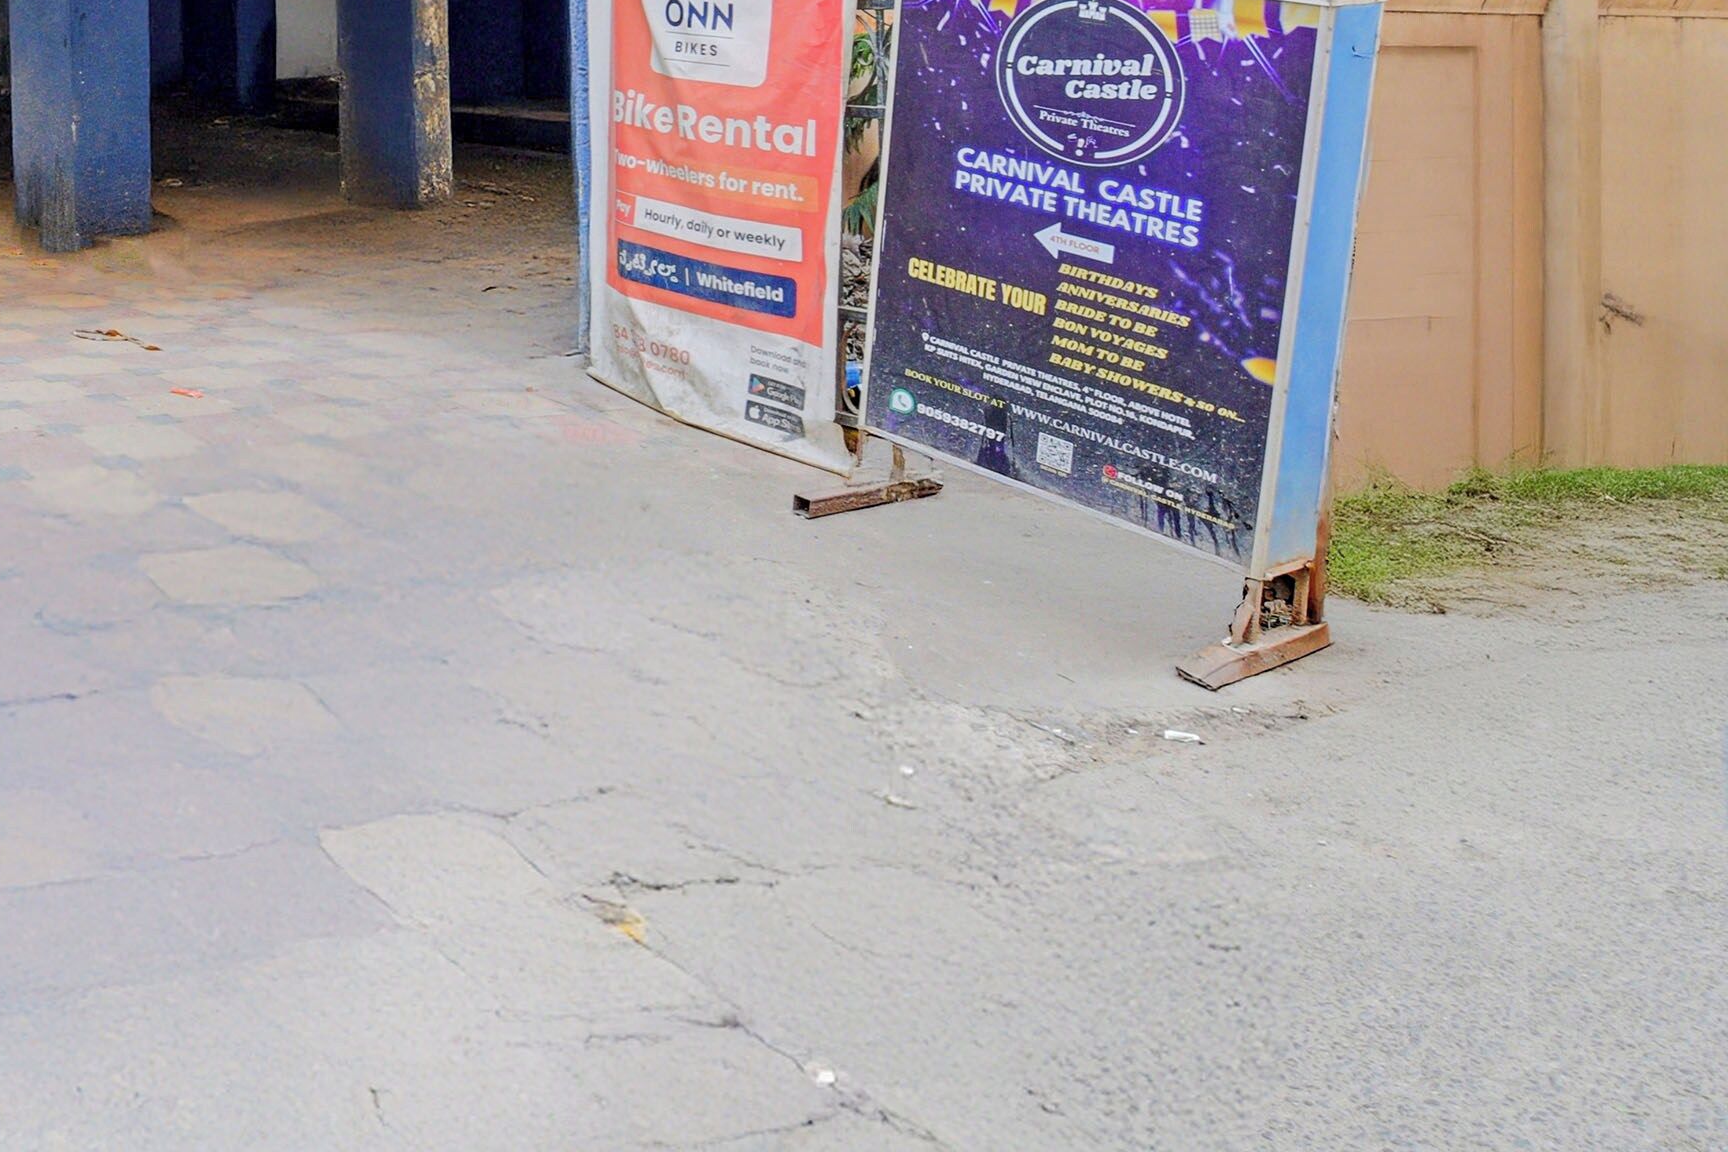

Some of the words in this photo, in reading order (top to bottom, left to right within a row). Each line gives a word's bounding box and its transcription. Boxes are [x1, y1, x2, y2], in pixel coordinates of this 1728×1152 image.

[674, 40, 719, 57] BIKES
[1016, 52, 1154, 78] Carnival
[1065, 78, 1157, 102] Castle
[1039, 110, 1078, 127] Private
[1080, 118, 1130, 138] Theatres
[615, 150, 715, 188] wo-wheelers
[719, 172, 747, 192] for
[752, 180, 805, 202] rent.
[956, 147, 1085, 194] CARNIVAL
[1098, 179, 1204, 222] CASTLE
[955, 170, 1057, 213] PRIVATE
[1063, 195, 1200, 248] THEATRES
[644, 208, 685, 230] Hourly,
[686, 219, 714, 239] daily
[717, 228, 730, 239] or
[734, 232, 786, 252] weekly
[1049, 234, 1068, 246] 4TH
[1068, 237, 1100, 254] FLOOR
[696, 271, 784, 303] Whitefield
[907, 257, 996, 302] CELEBRATE
[1000, 282, 1048, 316] YOUR
[1058, 263, 1160, 299] BIRTHDAYS
[1054, 298, 1108, 323] BRIDE
[1109, 313, 1132, 330] TO
[1132, 321, 1159, 338] BE
[1056, 281, 1192, 328] ANNIVERSARIES
[750, 345, 792, 363] Download
[1050, 334, 1096, 357] MOM
[1096, 348, 1120, 365] TO
[1120, 355, 1146, 372] BE
[1052, 316, 1089, 336] BON
[1090, 326, 1170, 360] VOYAGES
[904, 368, 932, 385] BOOK
[931, 377, 962, 394] YOUR
[961, 386, 990, 404] SLOT
[989, 397, 1007, 409] AT
[929, 335, 969, 356] CARNIVAL
[969, 348, 1001, 365] CASTLE
[1002, 358, 1037, 377] PRIVATE
[1127, 401, 1161, 417] ABOVE
[1161, 411, 1192, 428] HOTEL
[984, 362, 1020, 381] GARDEN
[1019, 373, 1042, 389] VIEW
[1084, 395, 1109, 411] PLOT
[1034, 388, 1088, 414] TELANGANA
[1048, 351, 1097, 375] BABY
[1095, 366, 1185, 405] SHOWERS
[1196, 399, 1215, 413] SO
[915, 402, 1007, 443] 9059382797
[1010, 403, 1218, 485] WWW.CARNIVALCASTLE.COM
[1117, 471, 1165, 495] FOLLOW
[1165, 488, 1185, 502] ON
